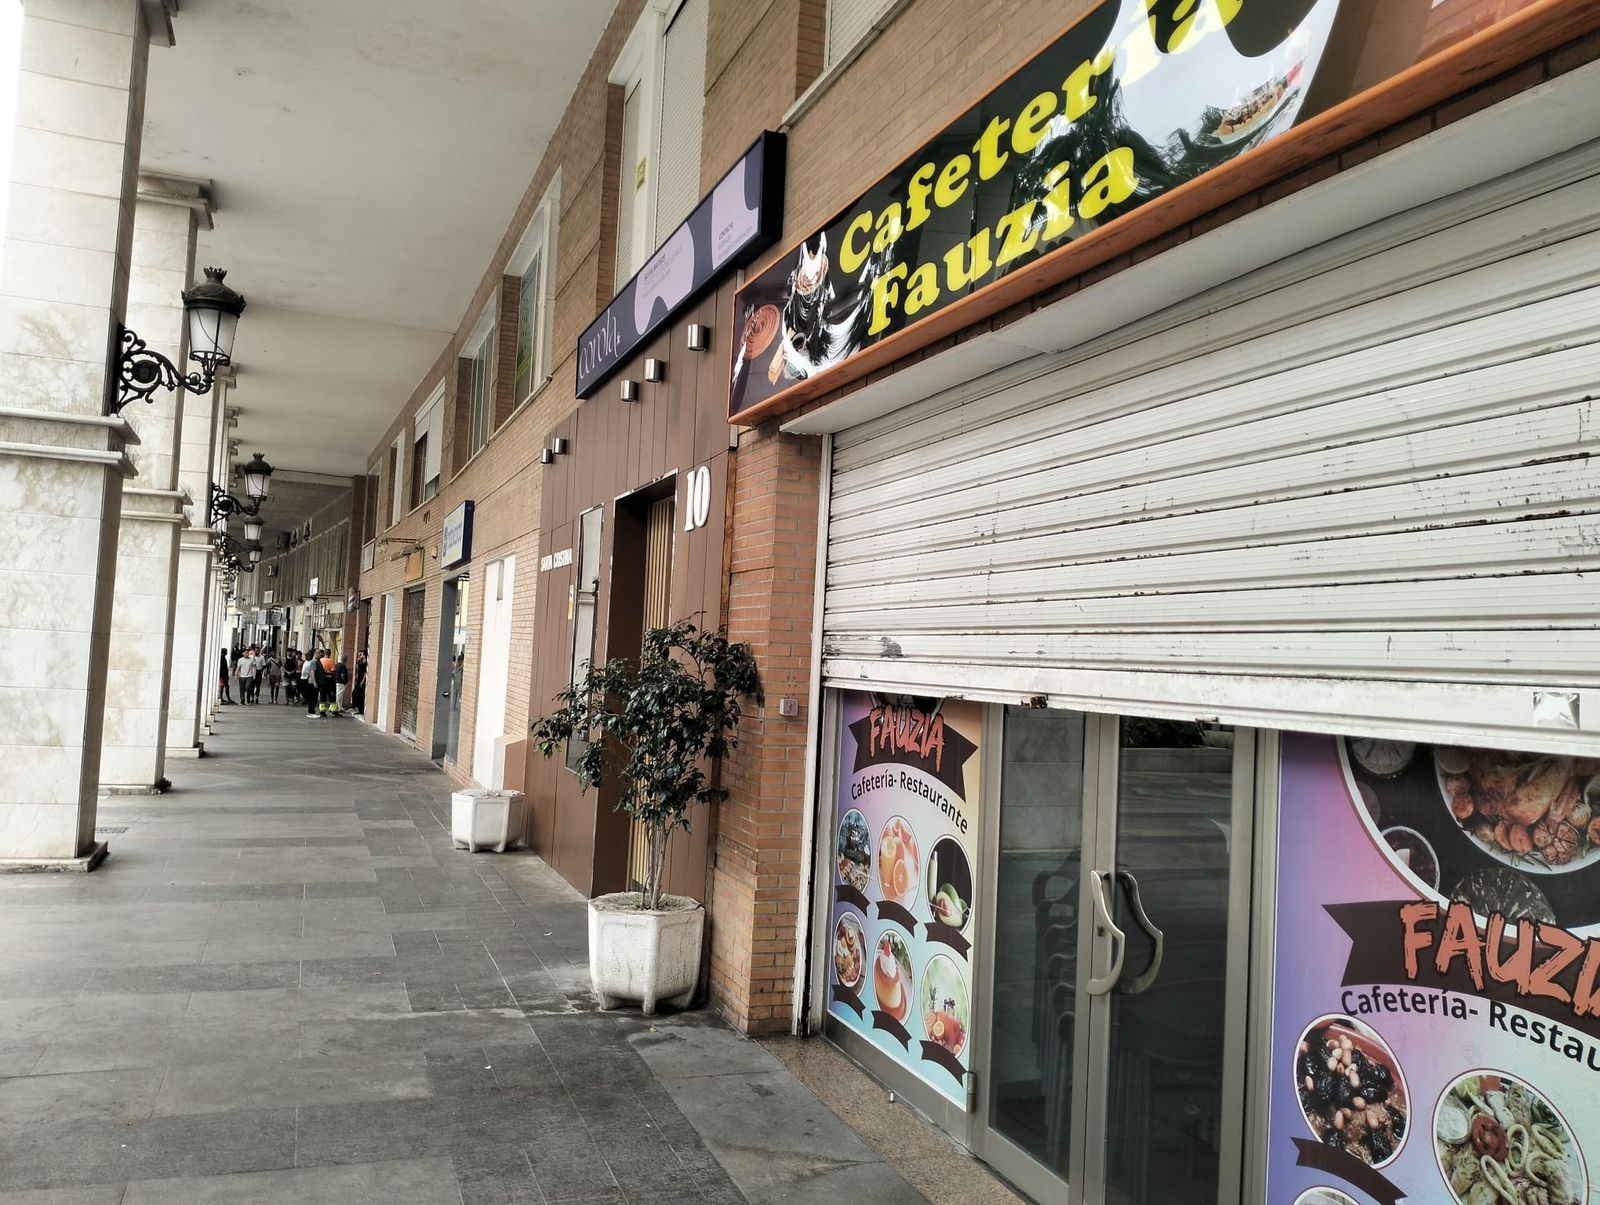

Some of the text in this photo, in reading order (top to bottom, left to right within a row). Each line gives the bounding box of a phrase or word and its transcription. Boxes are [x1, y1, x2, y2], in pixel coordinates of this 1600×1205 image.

[867, 146, 1140, 336] Fauzia
[684, 466, 711, 532] 10
[869, 703, 945, 774] FAUZIA
[900, 770, 969, 835] Restaurante
[1399, 900, 1600, 1017] FAUZI
